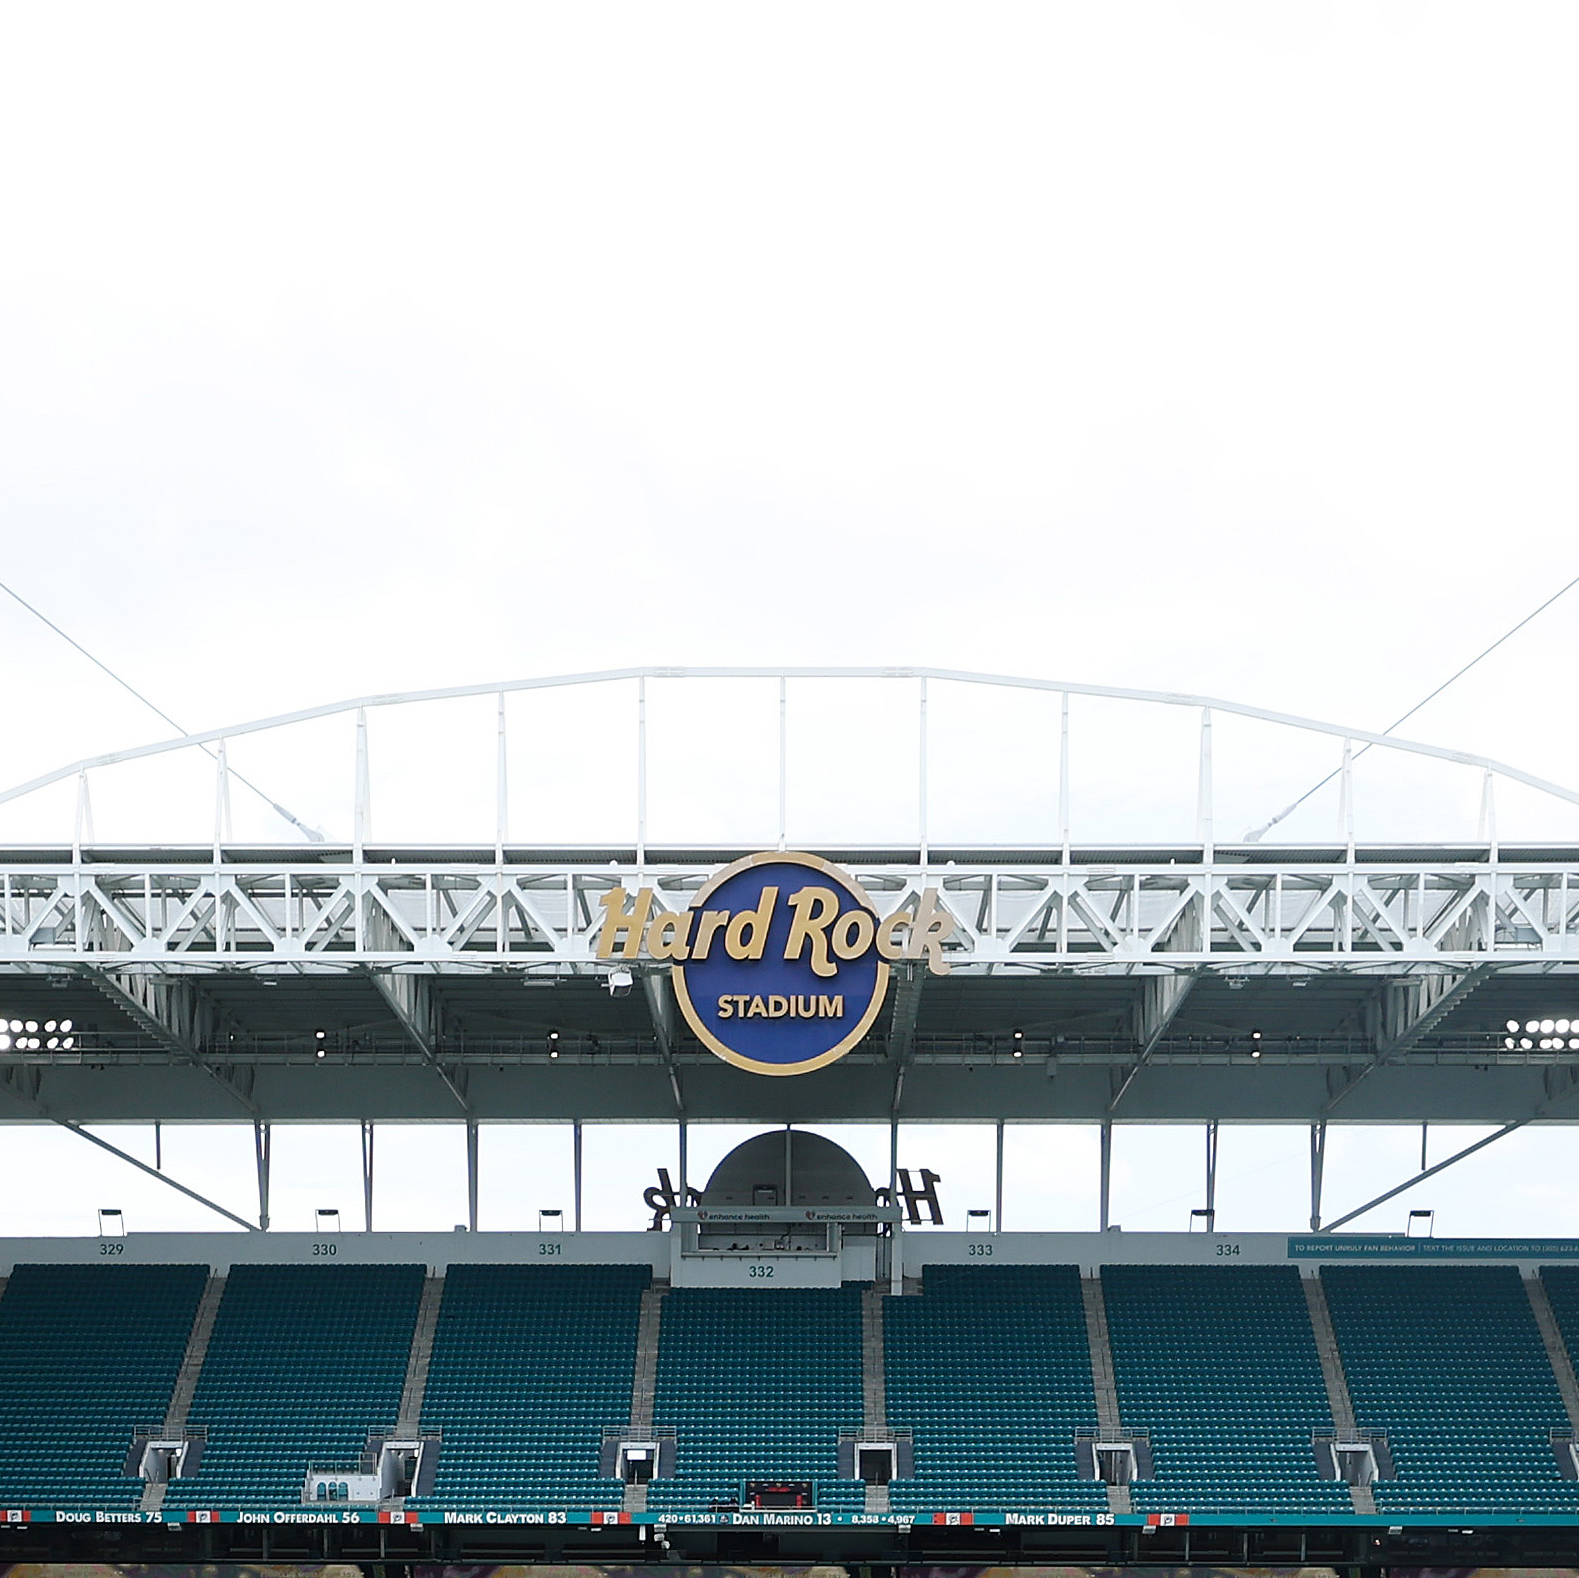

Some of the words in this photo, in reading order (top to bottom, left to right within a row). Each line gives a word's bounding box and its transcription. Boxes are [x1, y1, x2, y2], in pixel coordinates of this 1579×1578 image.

[596, 886, 779, 960] Hard
[783, 886, 954, 976] Rock
[717, 995, 844, 1019] STADIUM
[743, 1212, 770, 1221] health
[851, 1212, 877, 1221] health
[100, 1244, 124, 1256] 329
[312, 1244, 337, 1256] 330
[539, 1244, 561, 1256] 331
[968, 1244, 993, 1256] 333
[1216, 1244, 1240, 1256] 334
[749, 1266, 774, 1278] 332
[56, 1511, 92, 1523] DOUG
[95, 1511, 142, 1523] BETTERS
[145, 1511, 163, 1523] 75
[237, 1511, 269, 1524] JOHN
[273, 1511, 339, 1523] OFFERDAHL
[342, 1512, 360, 1524] 56
[444, 1512, 483, 1524] MARK
[486, 1512, 544, 1524] CLAYTON
[548, 1512, 567, 1524] 83
[732, 1513, 761, 1525] DAN
[763, 1513, 813, 1525] MARINO
[817, 1513, 832, 1525] 13
[1005, 1514, 1044, 1525] MARK
[1047, 1514, 1091, 1525] DUPER
[1096, 1513, 1114, 1526] 85
